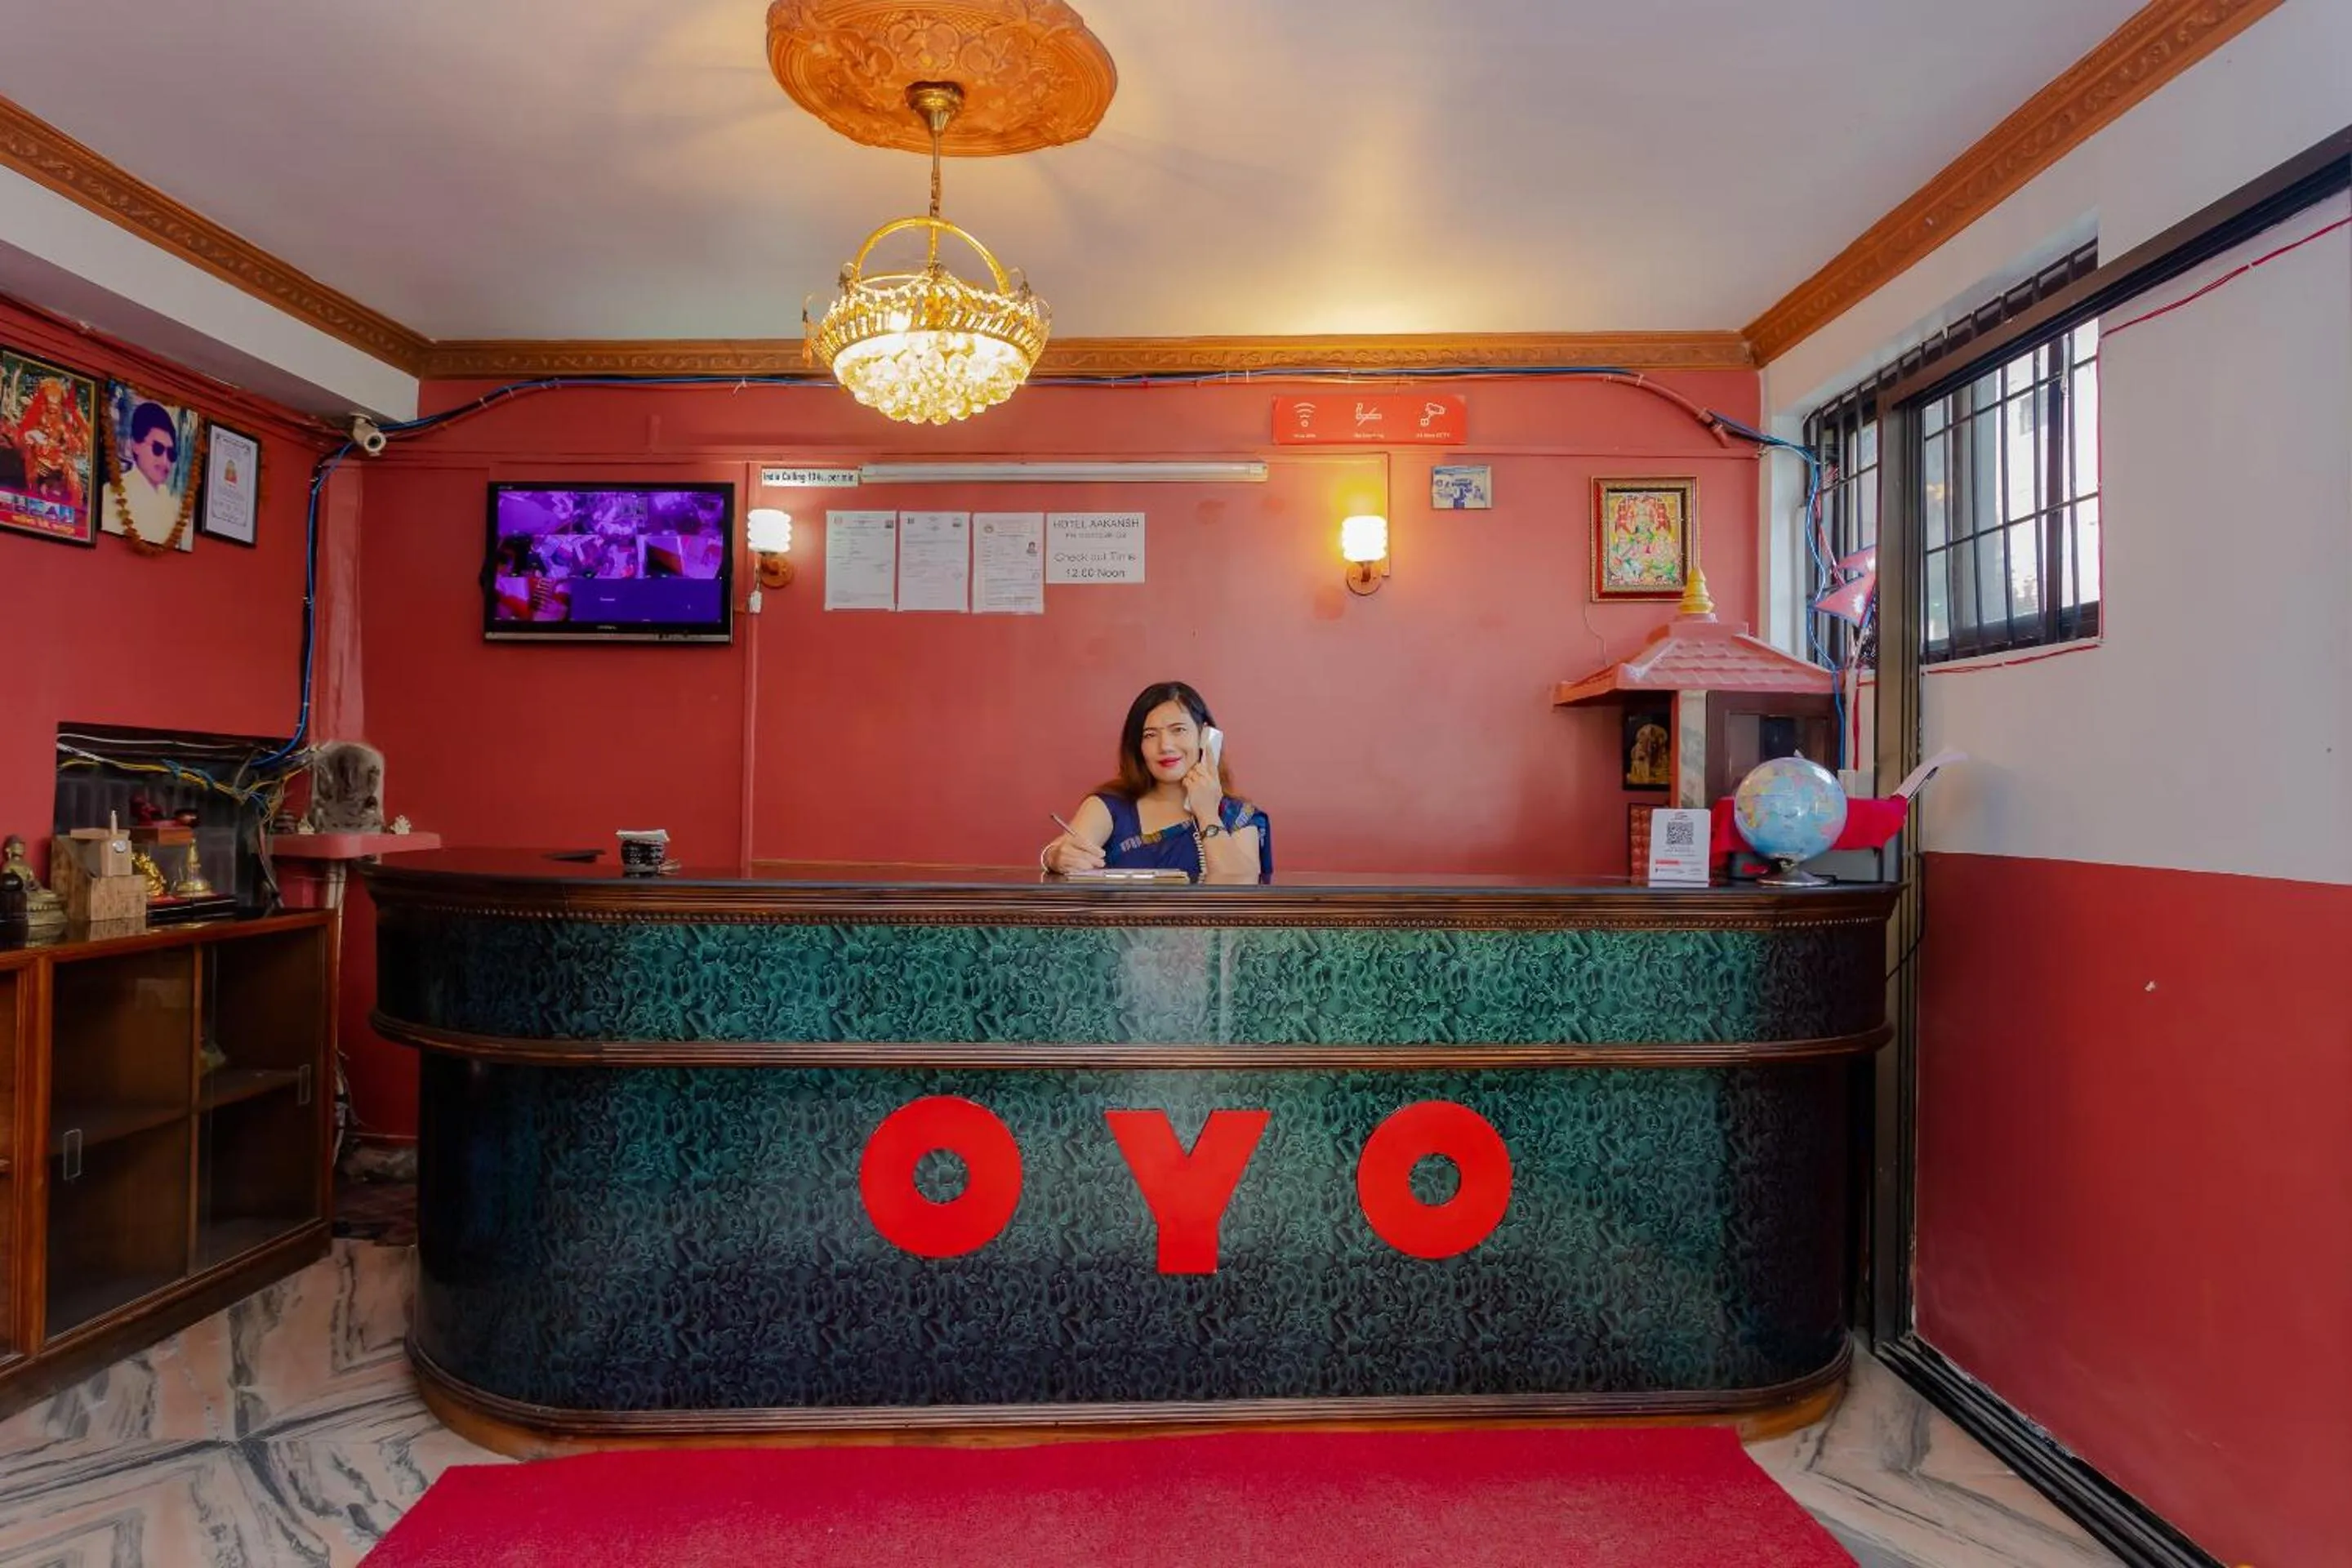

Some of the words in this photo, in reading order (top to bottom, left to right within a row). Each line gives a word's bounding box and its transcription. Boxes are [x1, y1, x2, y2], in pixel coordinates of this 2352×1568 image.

[1053, 519, 1087, 529] HOTEL
[1053, 552, 1089, 562] Check
[1097, 568, 1126, 578] Noon
[860, 1096, 1513, 1275] OYO
